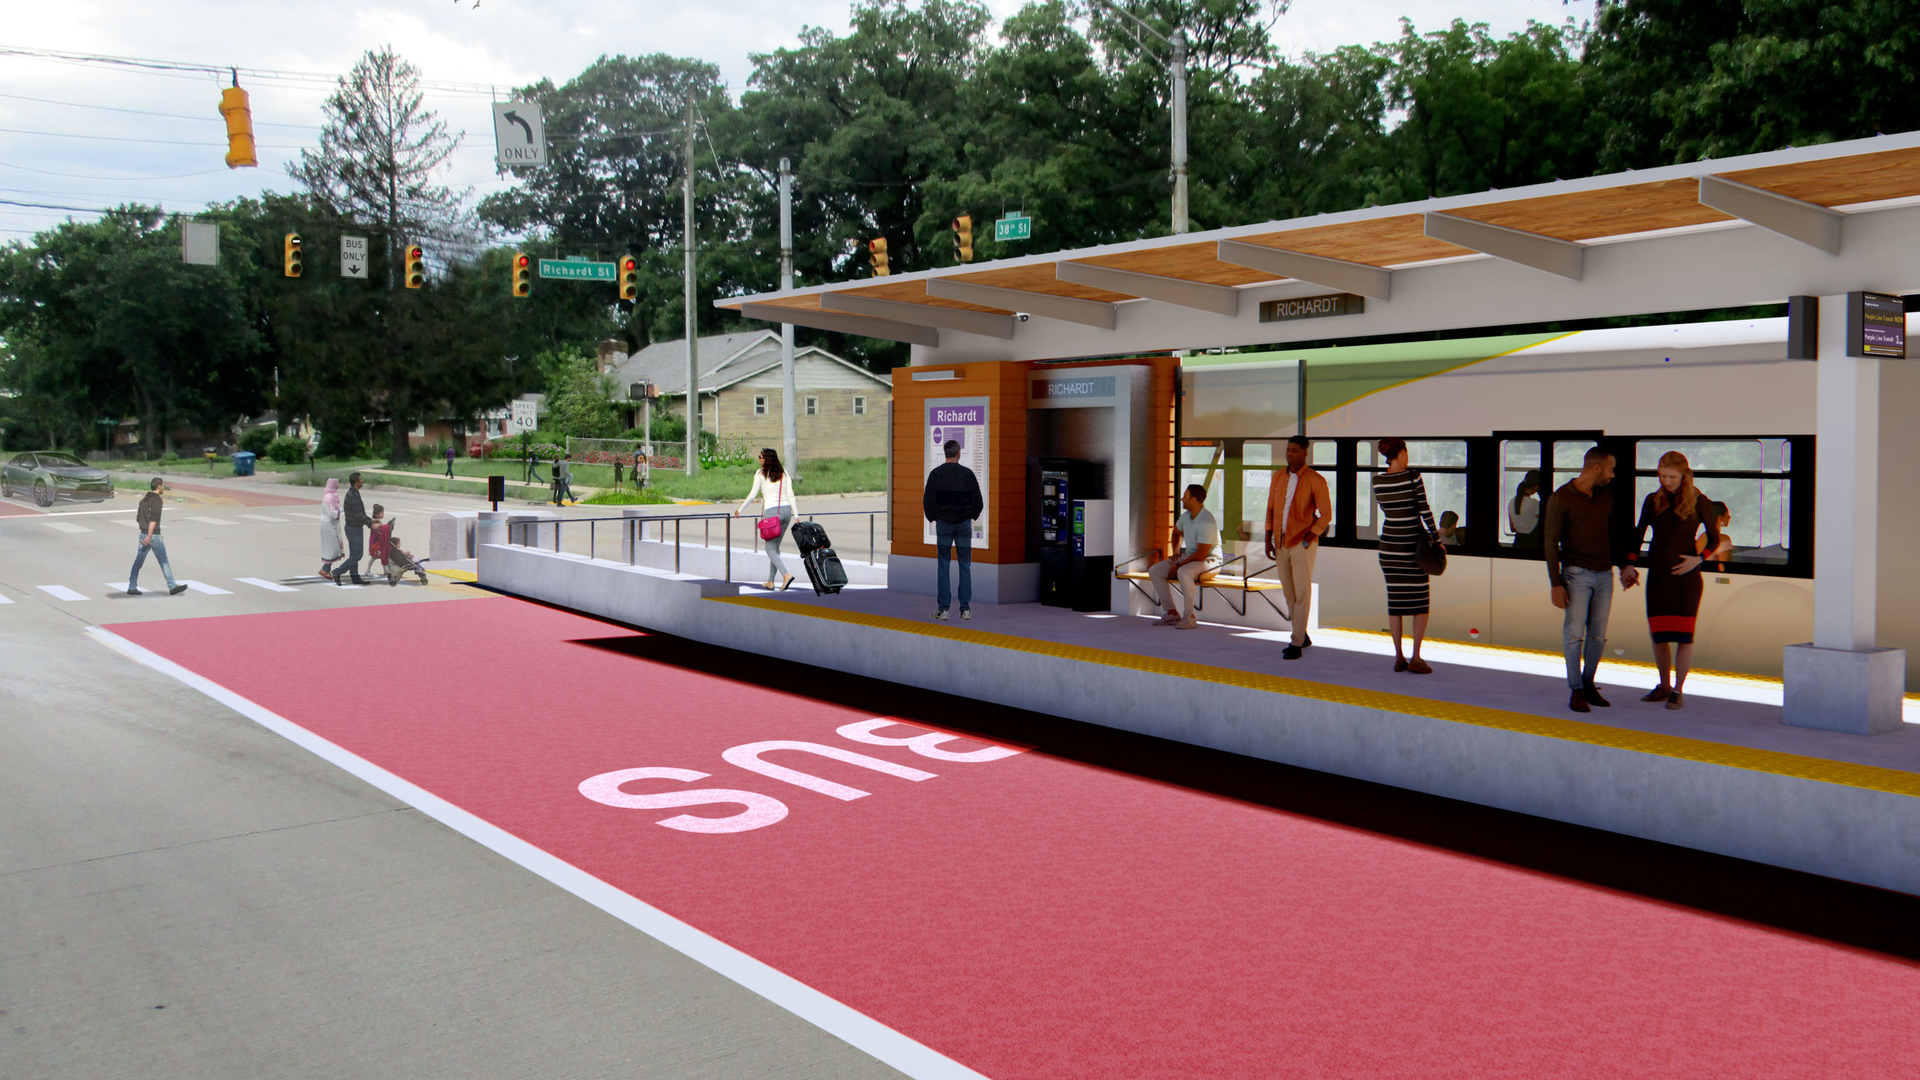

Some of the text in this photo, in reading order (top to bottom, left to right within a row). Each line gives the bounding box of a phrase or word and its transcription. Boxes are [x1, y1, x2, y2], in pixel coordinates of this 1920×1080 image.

[504, 147, 539, 160] ONLY
[1017, 222, 1028, 234] St
[346, 239, 364, 249] BUS
[342, 251, 366, 261] ONLY
[543, 263, 610, 277] Richardt St
[1276, 297, 1339, 317] RICHARDT
[1047, 382, 1095, 395] RICHARDT
[516, 417, 533, 427] 40
[937, 409, 977, 422] Richardt
[578, 717, 1028, 834] BUS
